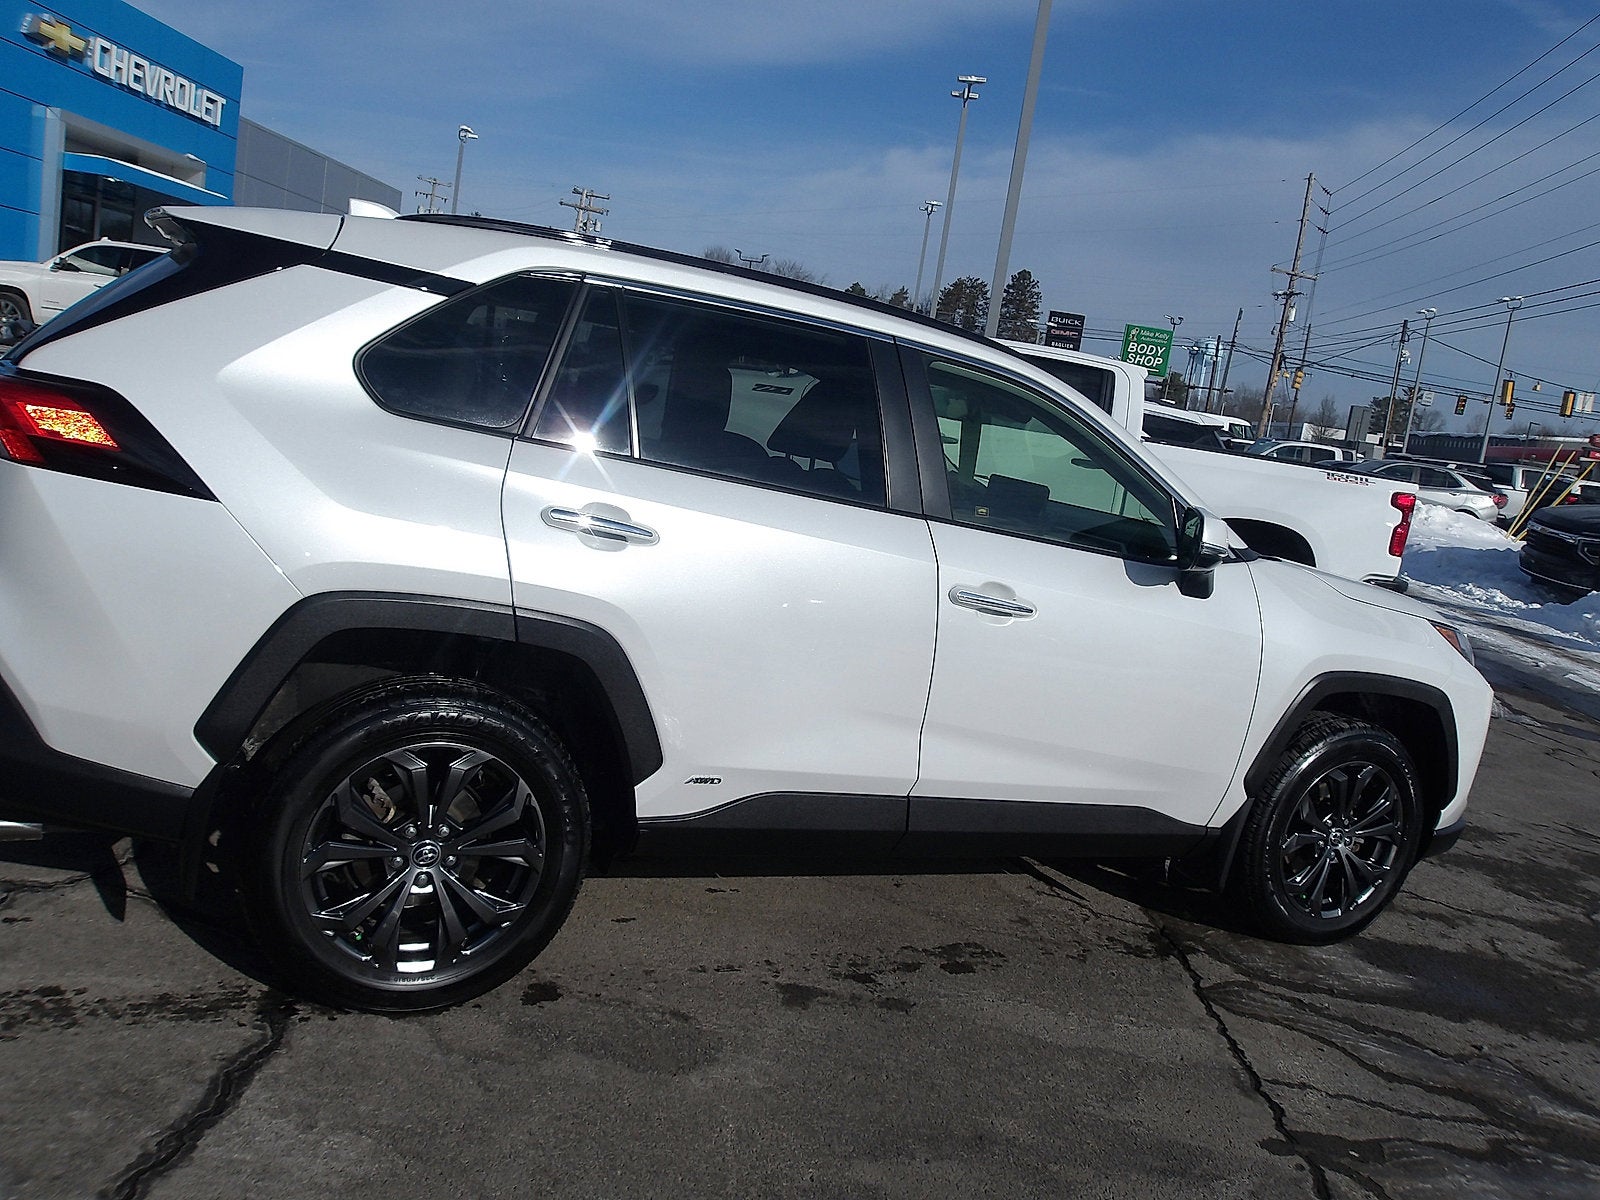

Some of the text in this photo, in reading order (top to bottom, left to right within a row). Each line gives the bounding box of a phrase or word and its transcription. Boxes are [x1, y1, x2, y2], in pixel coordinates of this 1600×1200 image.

[93, 36, 227, 127] CHEVROLET
[1050, 316, 1082, 326] BUICK
[1050, 328, 1079, 338] GMC
[1140, 329, 1170, 340] Mike Kelly
[1127, 342, 1166, 357] BODY
[1126, 353, 1163, 367] SHOP
[684, 777, 722, 785] AWD
